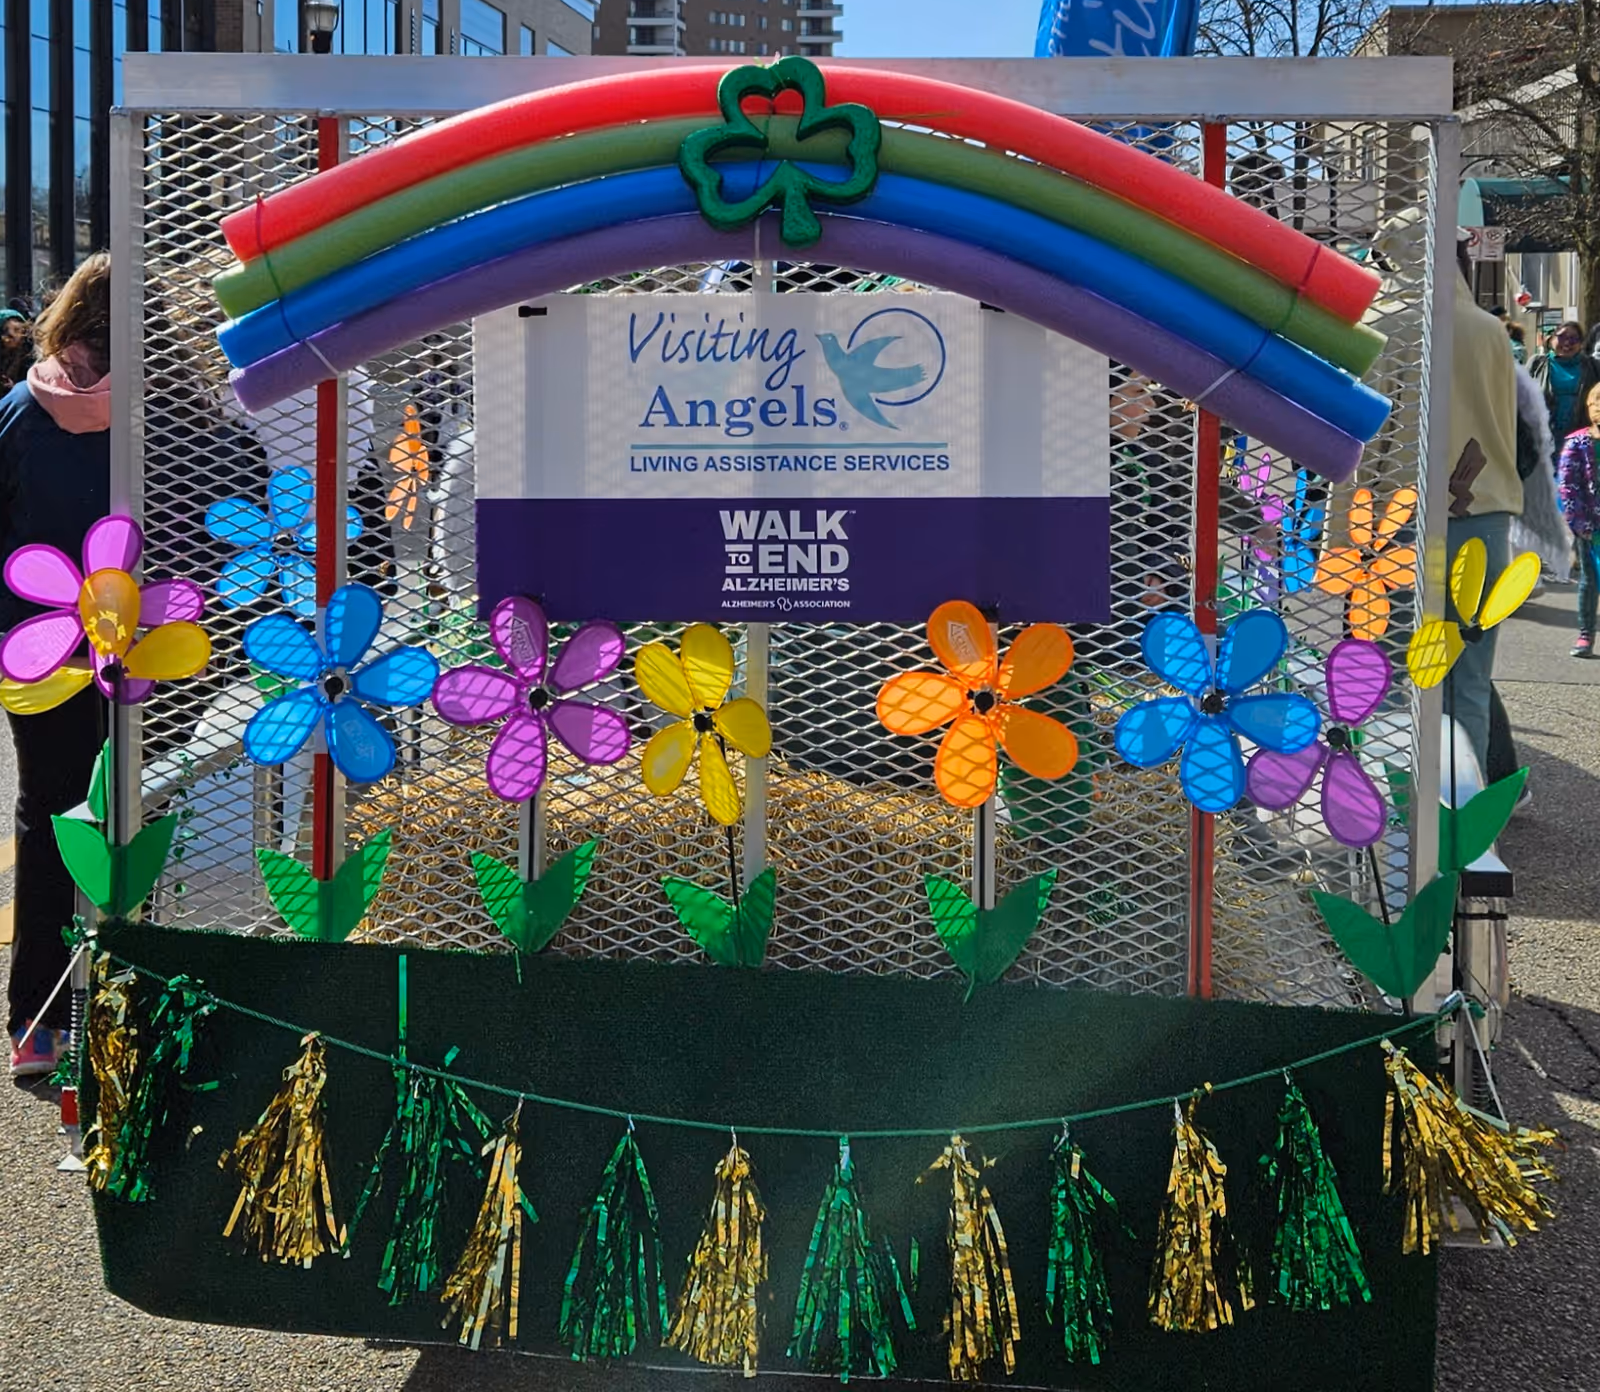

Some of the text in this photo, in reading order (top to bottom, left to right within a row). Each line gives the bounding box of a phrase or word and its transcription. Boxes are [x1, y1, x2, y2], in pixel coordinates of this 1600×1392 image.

[628, 311, 806, 391] Visiting
[630, 453, 950, 473] LIVING ASSISTANCE SERVICES
[728, 543, 850, 575] TO END
[721, 577, 850, 592] ALZHEIMER'S
[721, 599, 851, 608] ALZHEIMER'S ASSOCIATION
